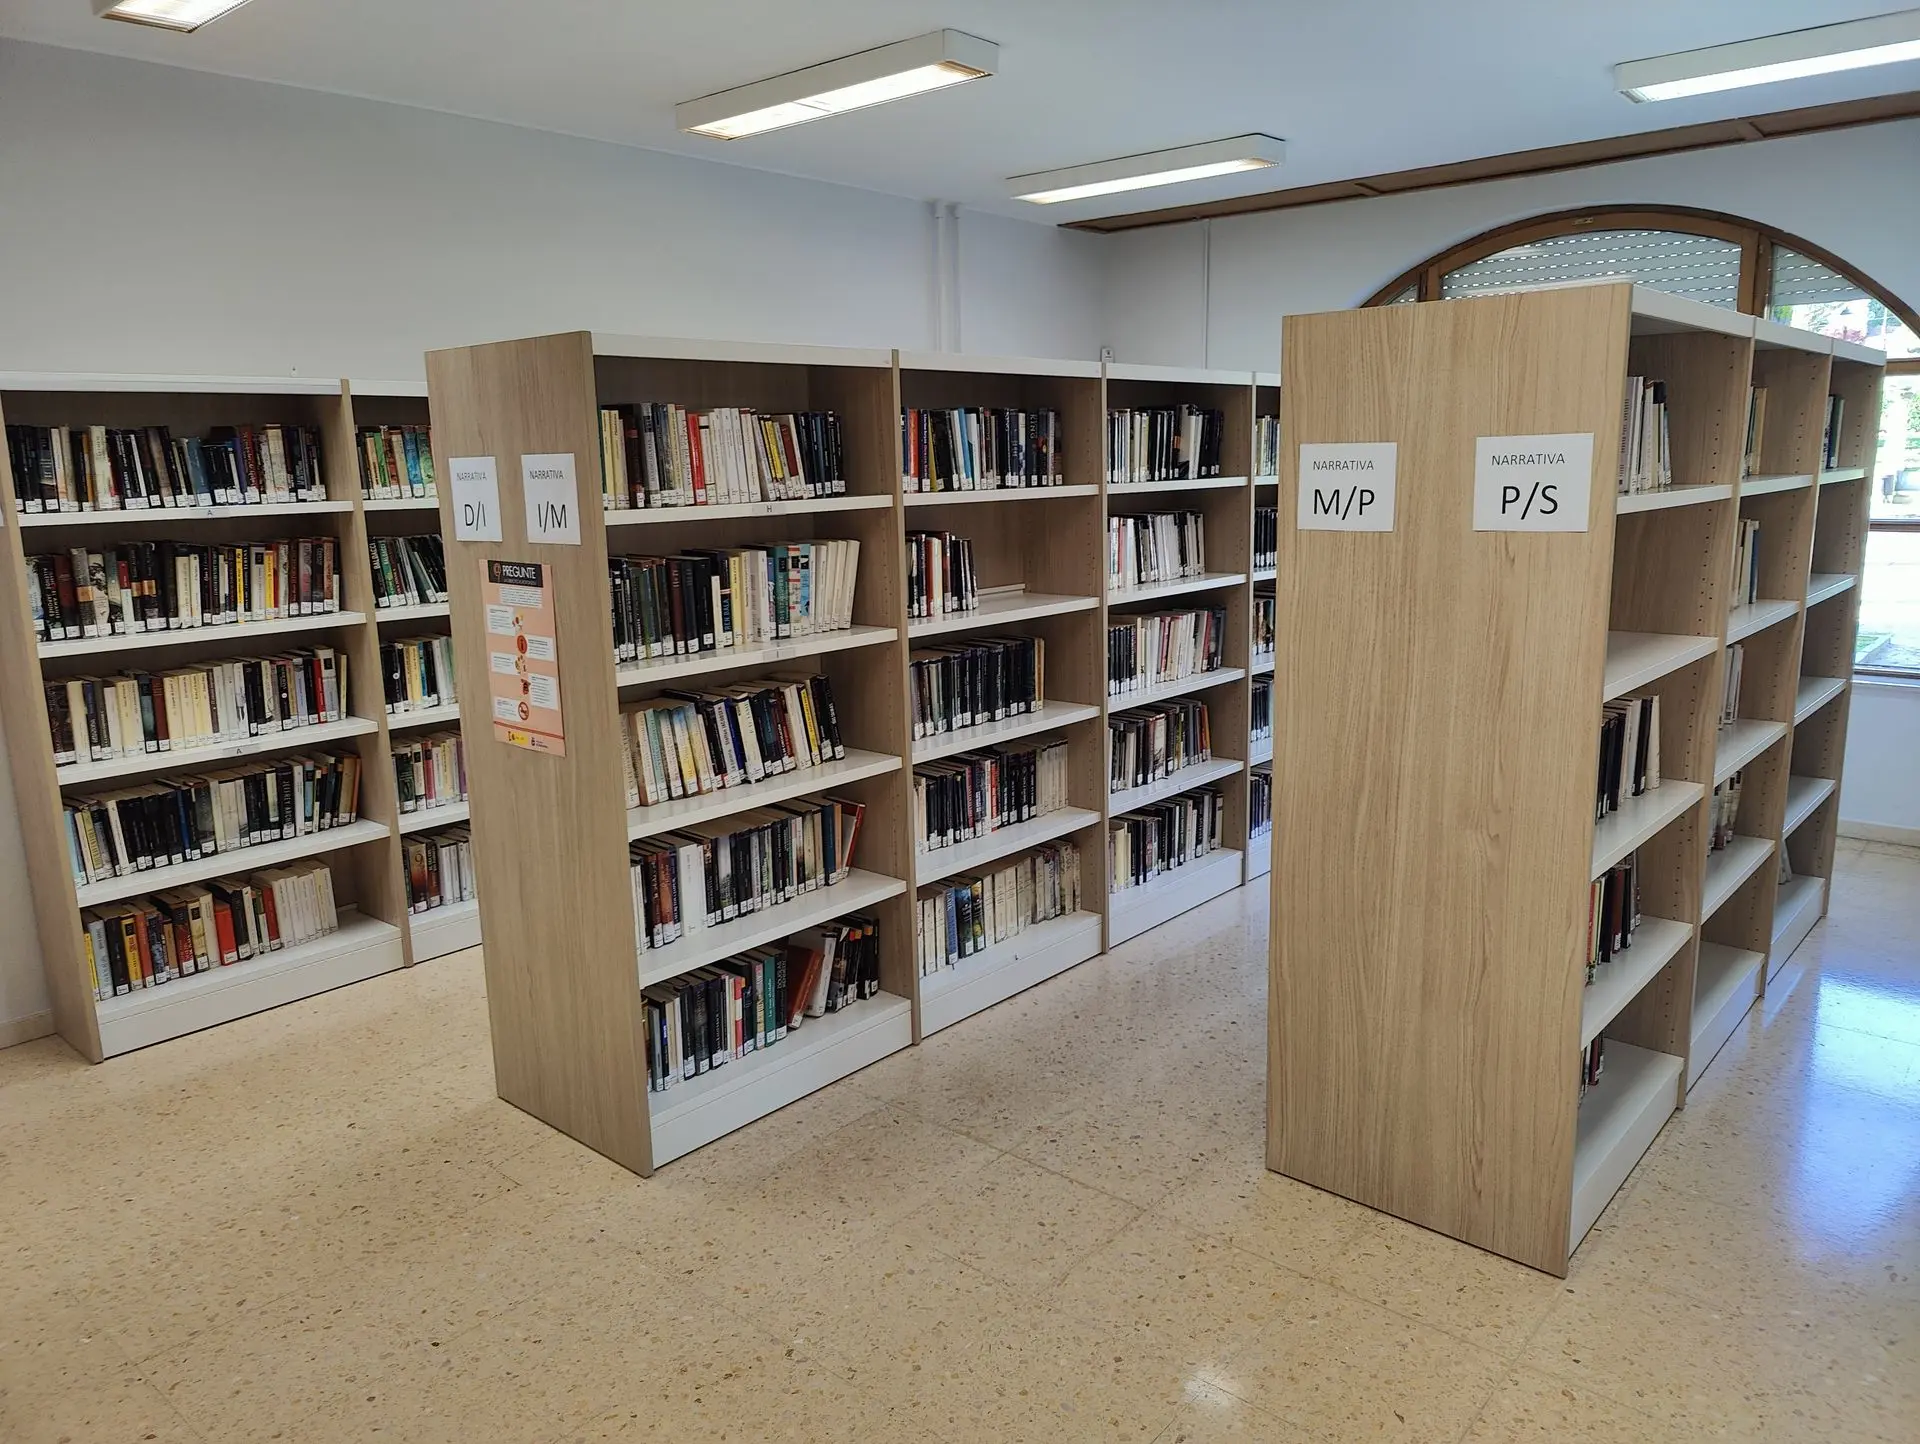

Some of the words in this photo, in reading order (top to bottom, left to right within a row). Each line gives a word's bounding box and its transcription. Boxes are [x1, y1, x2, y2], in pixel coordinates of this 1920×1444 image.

[1312, 460, 1374, 471] NARRATIVA
[1491, 453, 1565, 466] NARRATIVA
[456, 472, 487, 481] NARRATIVA
[529, 470, 564, 480] NARRATIVA
[1313, 486, 1376, 520] M/P
[1501, 482, 1559, 520] P/S
[464, 501, 487, 531] D/I
[537, 501, 567, 533] I/M
[502, 565, 537, 579] PREGUNTE
